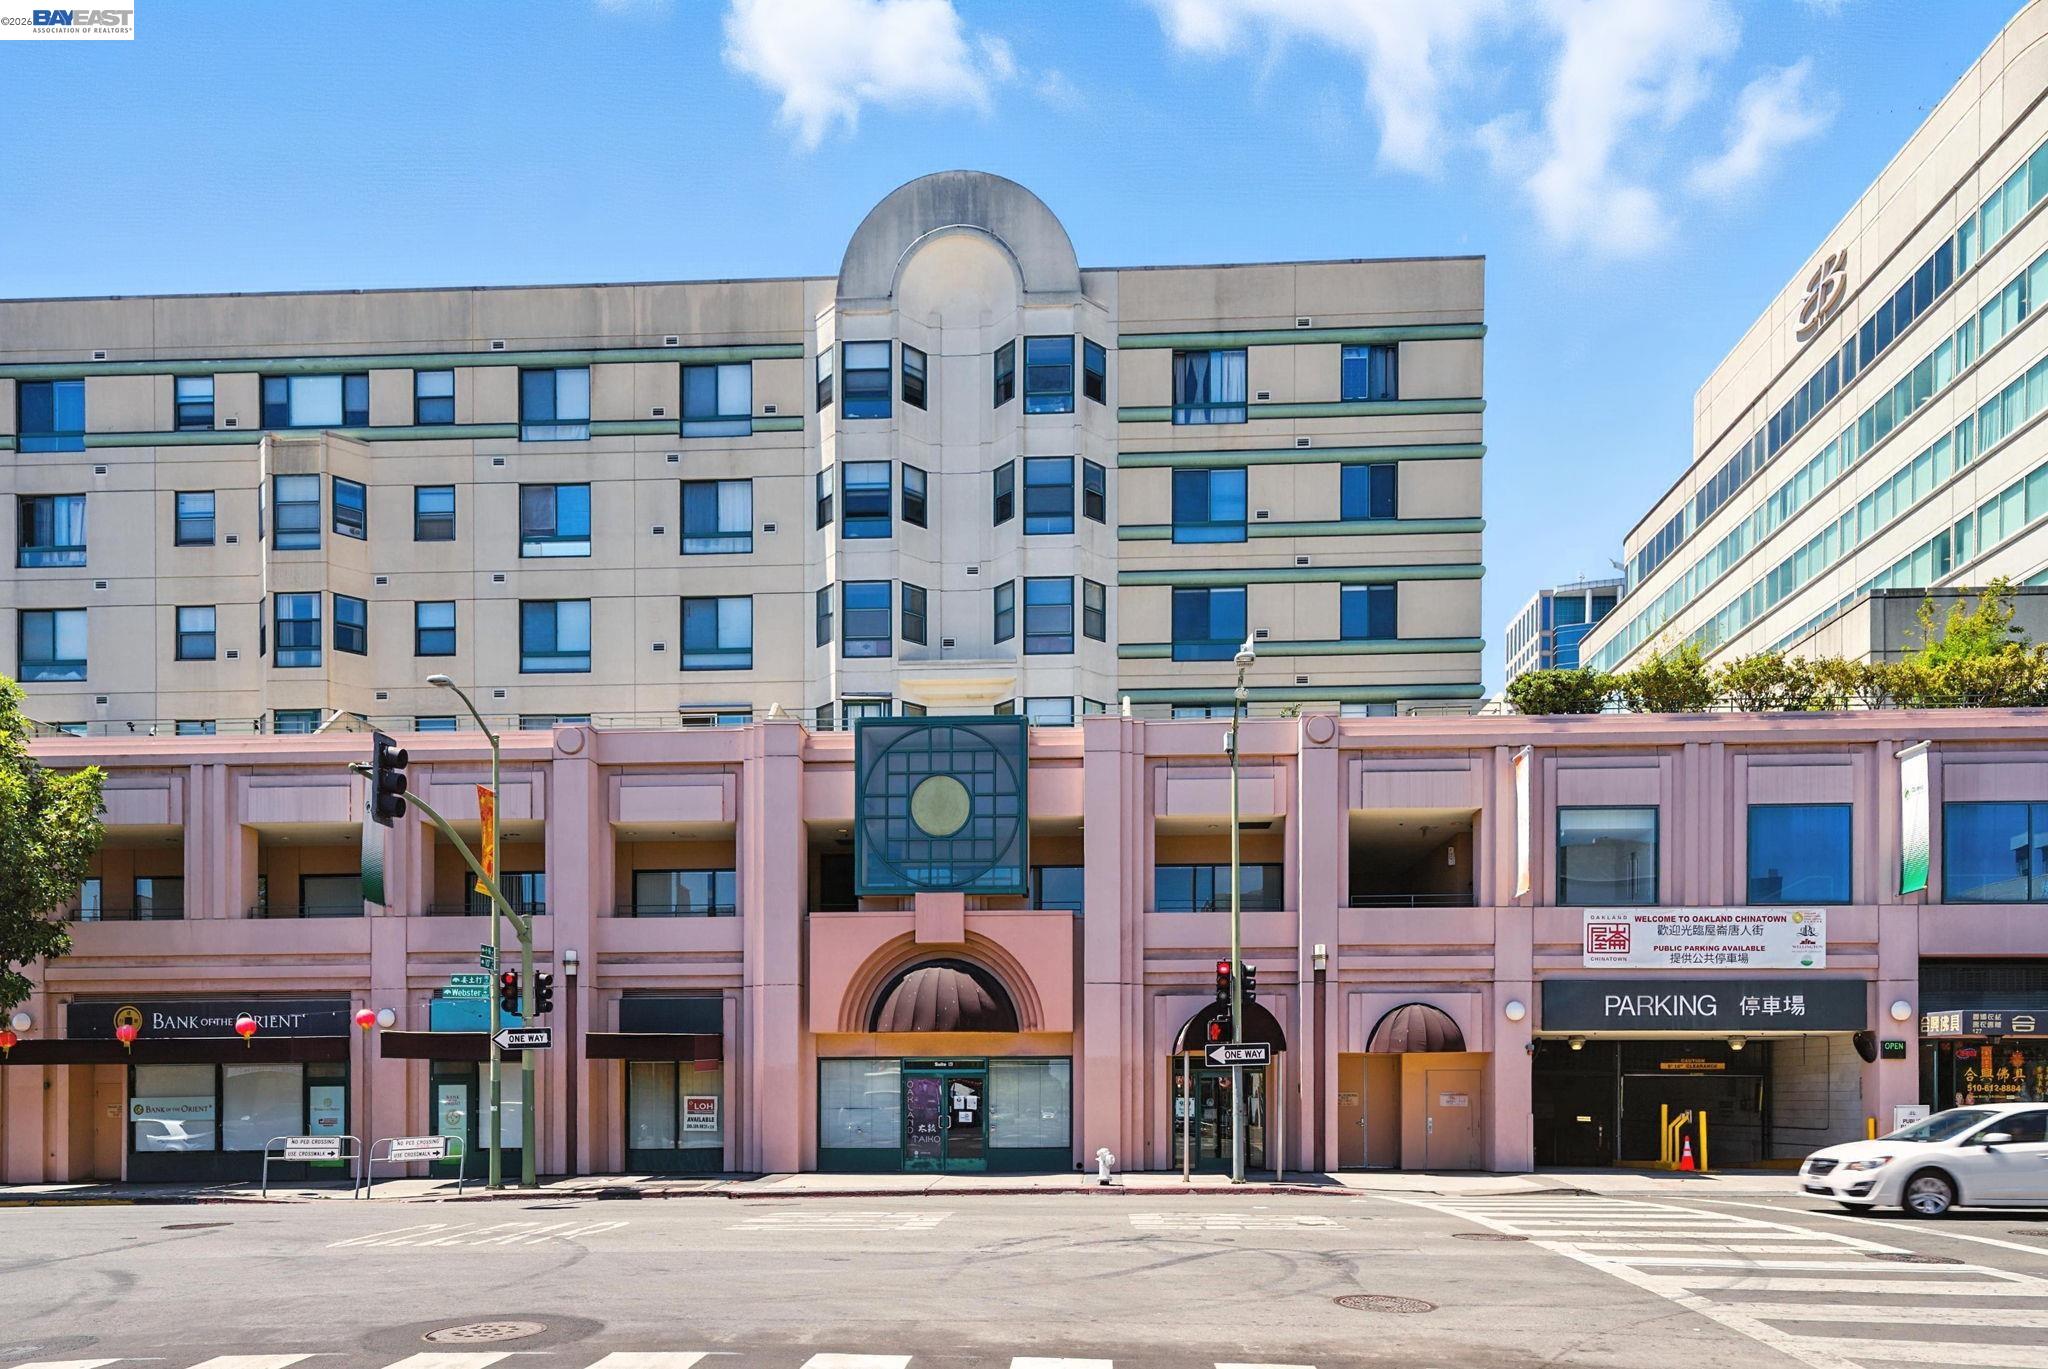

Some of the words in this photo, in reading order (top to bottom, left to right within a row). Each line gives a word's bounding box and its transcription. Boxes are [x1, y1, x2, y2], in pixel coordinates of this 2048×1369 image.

[1634, 915, 1676, 923] WELCOME
[1678, 915, 1690, 923] TO
[1692, 915, 1733, 923] OAKLAND
[1735, 915, 1787, 923] CHINATOWN
[1657, 924, 1764, 936] 歡迎光臨屋崙唐人街
[1670, 953, 1749, 964] 提供公共停車場
[451, 988, 481, 997] Webster
[1604, 994, 1717, 1017] PARKING
[1739, 994, 1806, 1017] 停車場
[153, 1012, 200, 1030] BANK
[1920, 1014, 1960, 1033] 合興佛具
[508, 1034, 525, 1043] ONE
[527, 1034, 545, 1042] WAY
[1884, 1042, 1904, 1050] OPEN
[1224, 1050, 1242, 1059] ONE
[1244, 1050, 1263, 1058] WAY
[145, 1105, 165, 1114] BANK
[181, 1104, 208, 1113] ORIENT
[694, 1102, 714, 1110] LOH
[906, 1080, 914, 1134] OAKLAND
[912, 1135, 941, 1143] TAIKO
